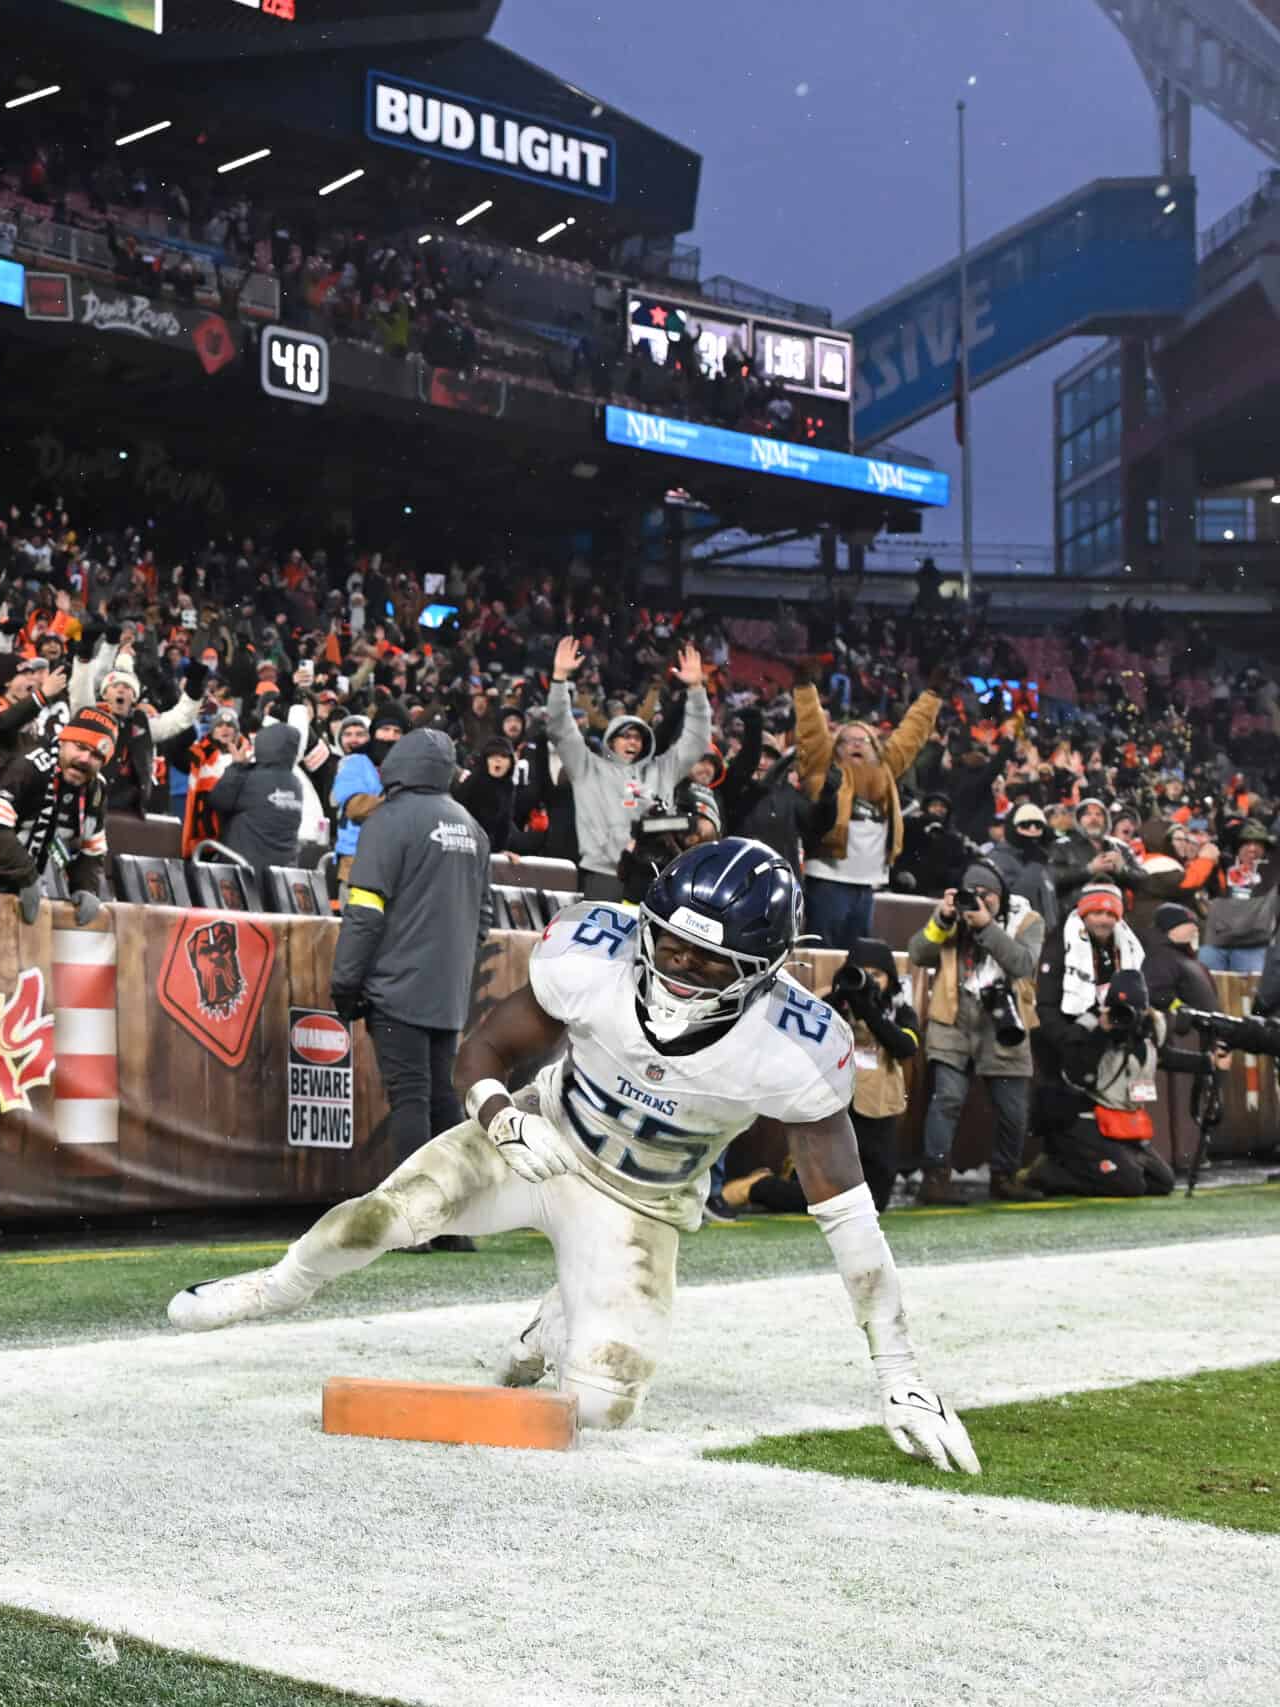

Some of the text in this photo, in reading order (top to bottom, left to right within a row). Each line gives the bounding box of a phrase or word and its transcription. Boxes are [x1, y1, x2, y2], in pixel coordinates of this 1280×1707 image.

[375, 84, 608, 187] BUD LIGHT
[271, 340, 320, 393] 40
[626, 412, 667, 446] NJM
[751, 436, 791, 471] NJM
[867, 460, 906, 493] NJM
[290, 1066, 351, 1099] BEWARE
[616, 1075, 678, 1116] TITANS
[290, 1103, 351, 1144] OF DAWG
